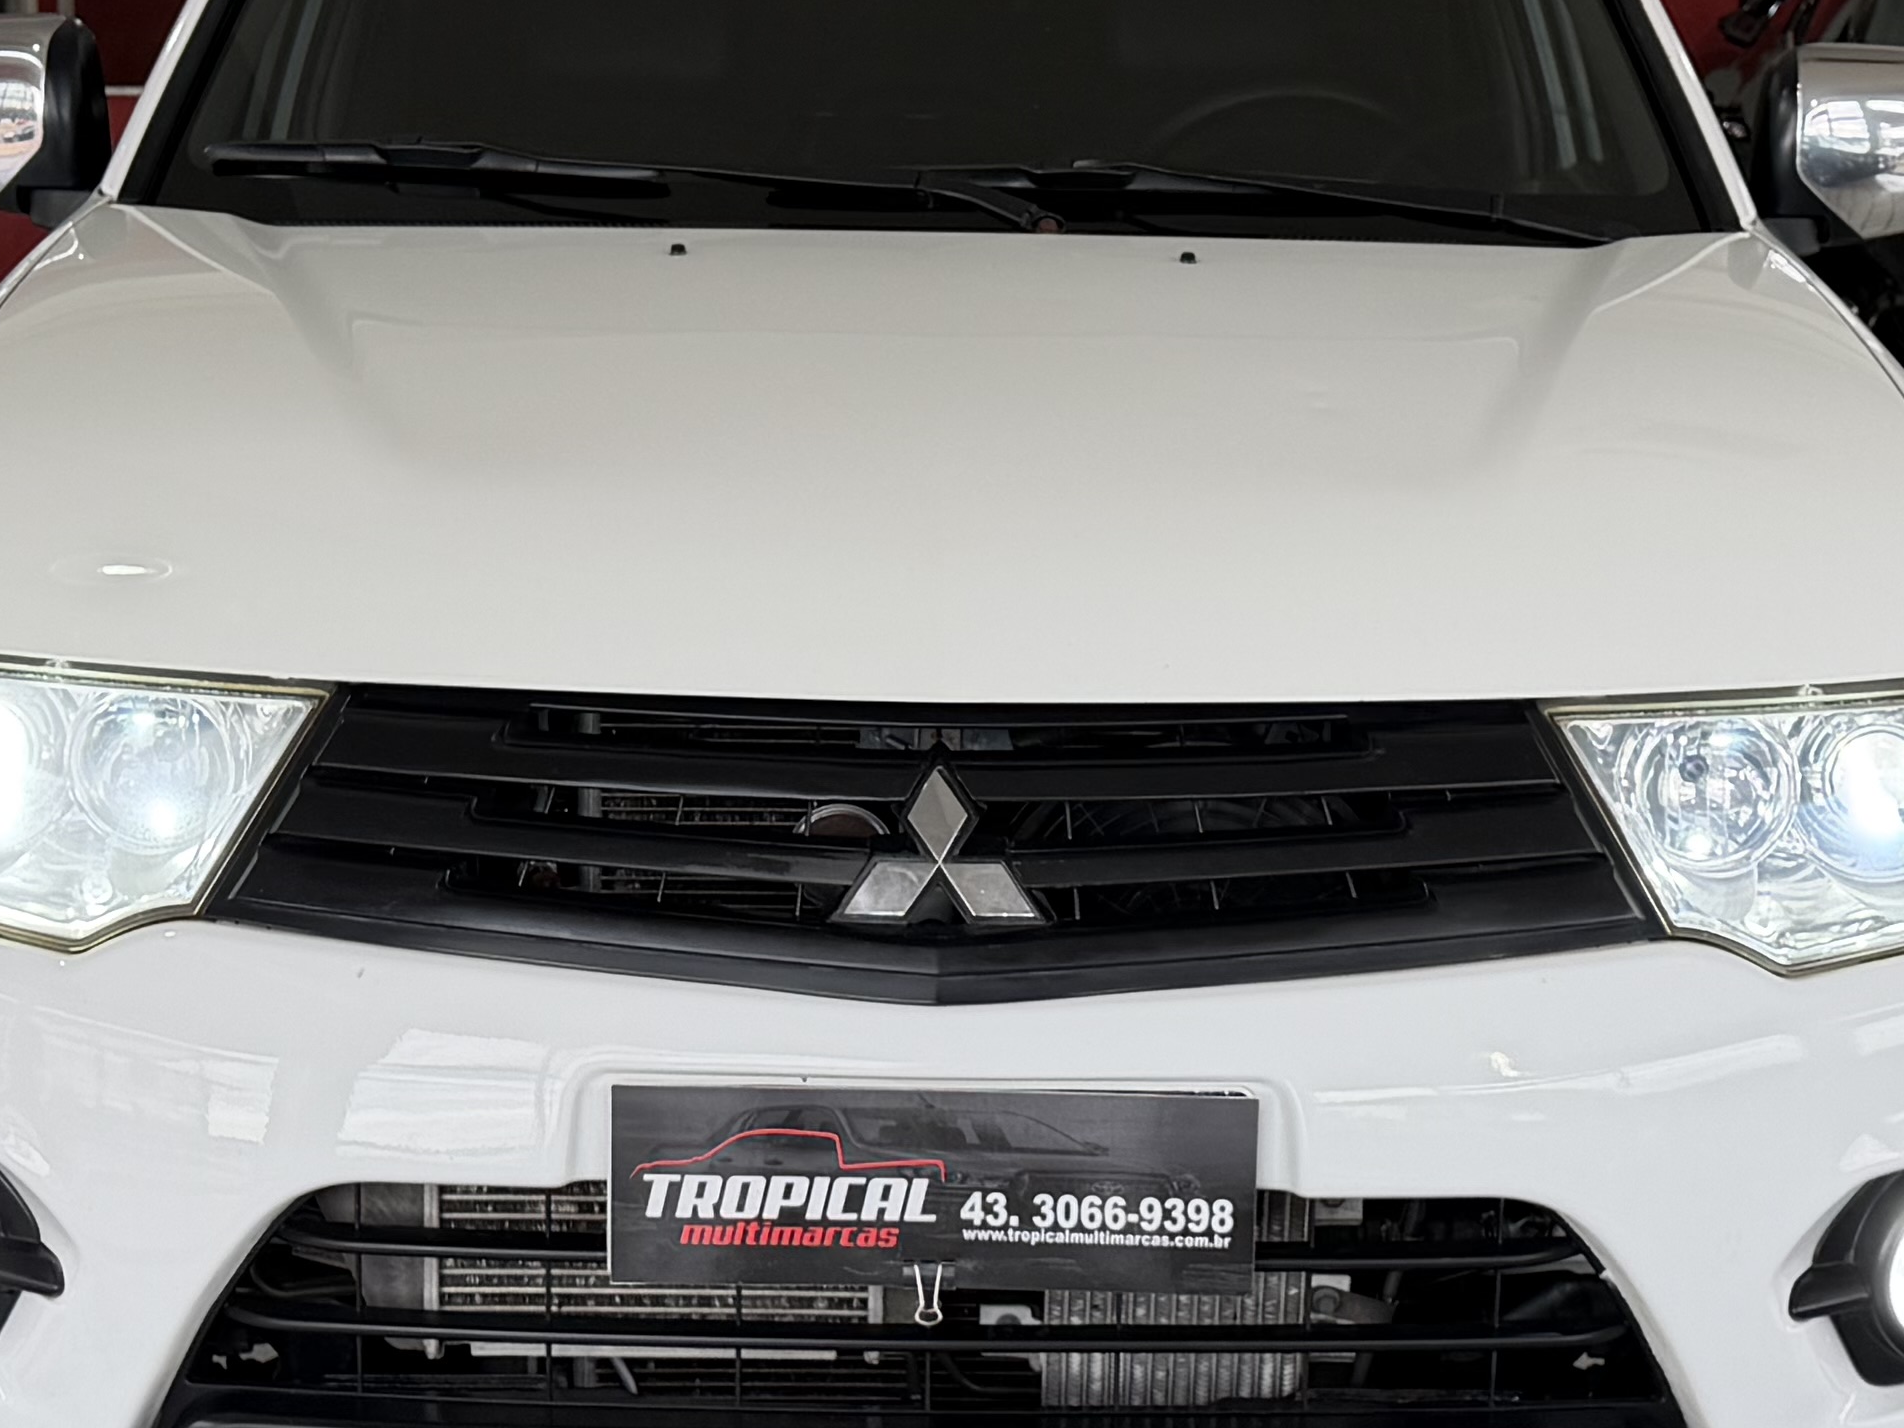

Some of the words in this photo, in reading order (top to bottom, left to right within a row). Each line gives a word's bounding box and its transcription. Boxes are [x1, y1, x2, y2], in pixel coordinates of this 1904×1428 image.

[642, 1172, 937, 1224] TROPICAL
[959, 1191, 1019, 1228] 43.
[1032, 1192, 1235, 1234] 3066-9398
[679, 1220, 900, 1249] multimarcas
[962, 1227, 1232, 1249] www.tropicalmultimarcas.com.br
